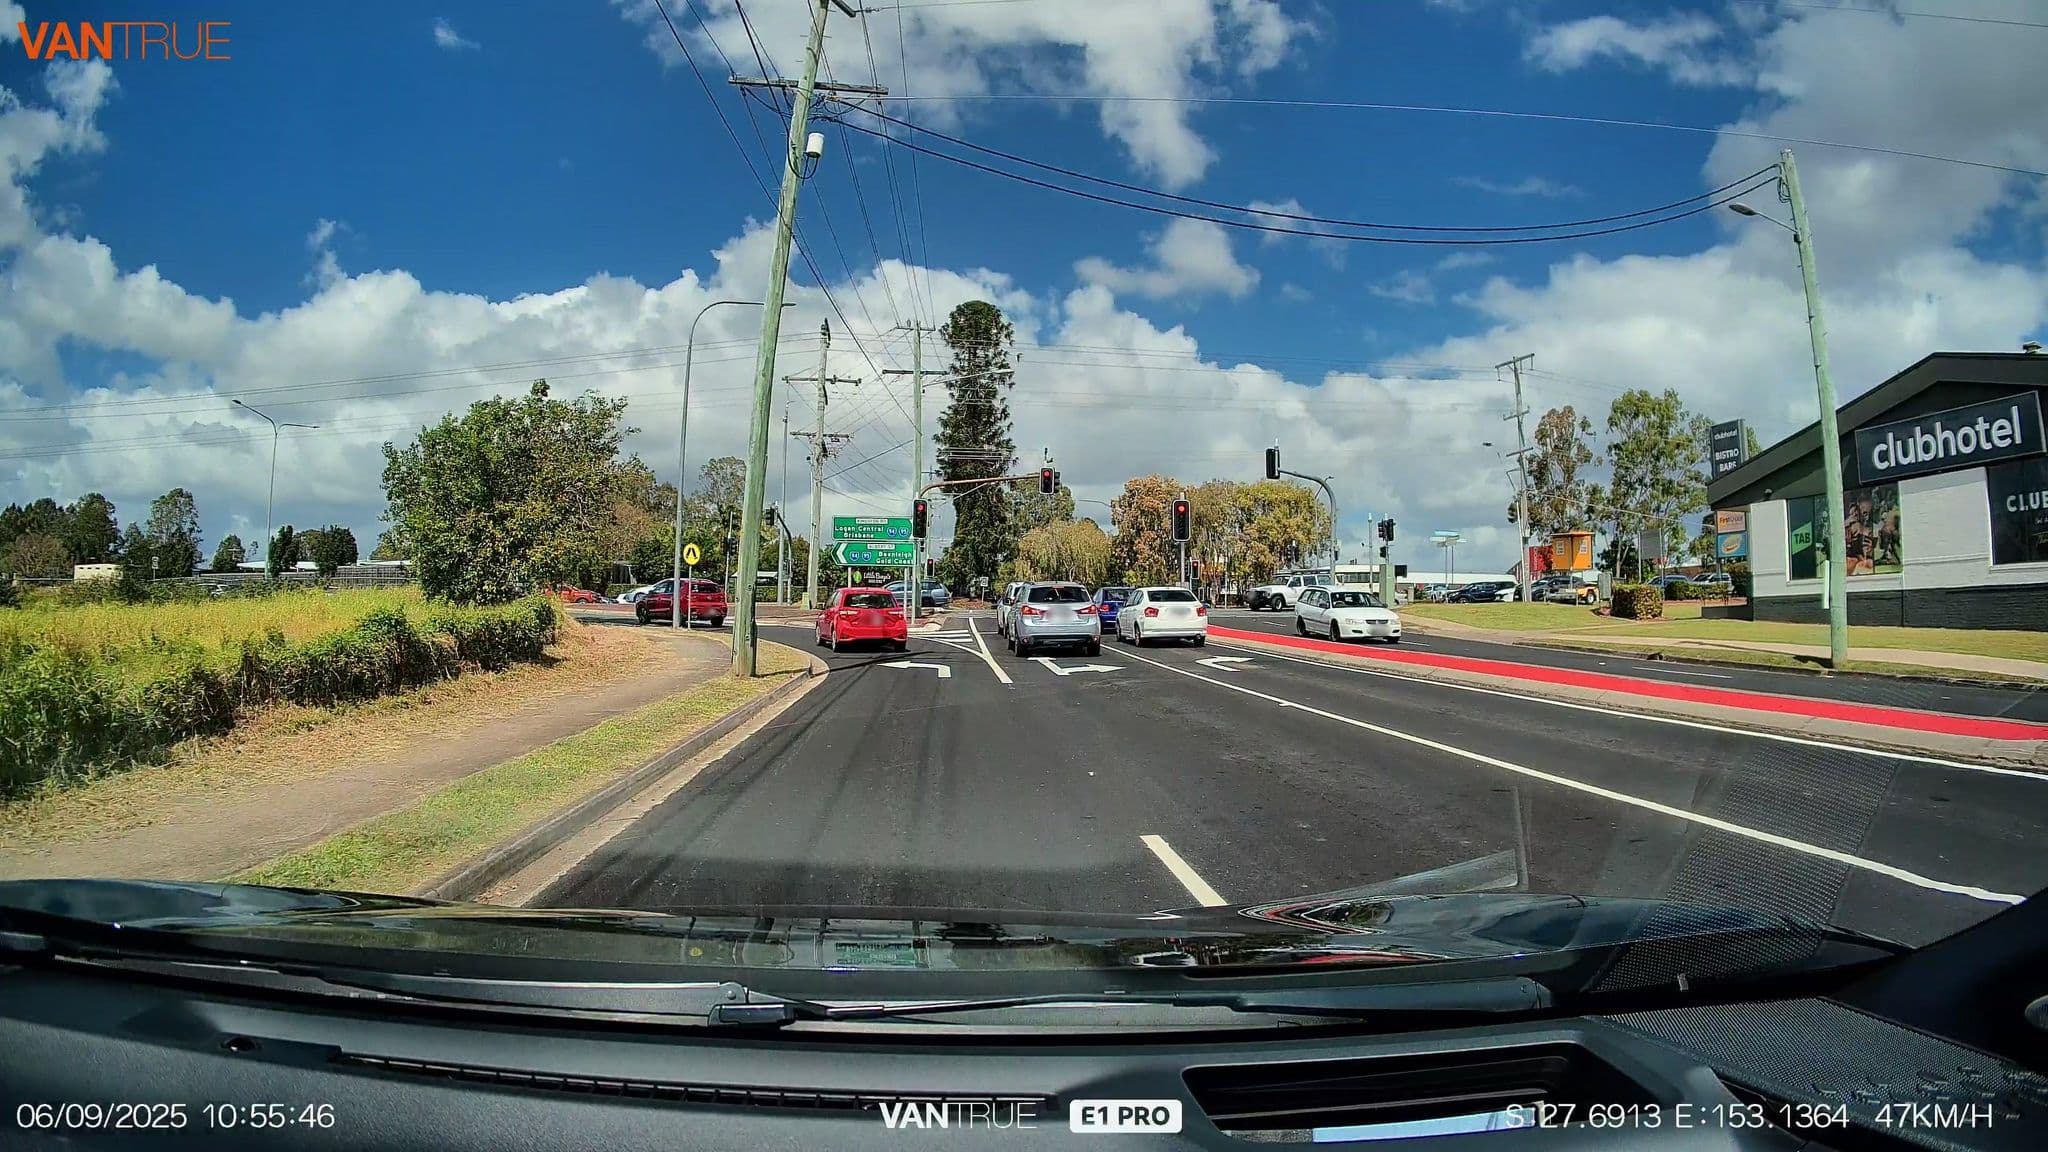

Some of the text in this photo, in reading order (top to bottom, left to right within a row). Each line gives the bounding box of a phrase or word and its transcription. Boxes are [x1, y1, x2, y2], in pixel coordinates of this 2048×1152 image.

[1873, 405, 2022, 470] clubhotel
[1715, 448, 1740, 461] BISTRO
[1794, 532, 1811, 545] TAB
[878, 551, 913, 559] Beenleigh
